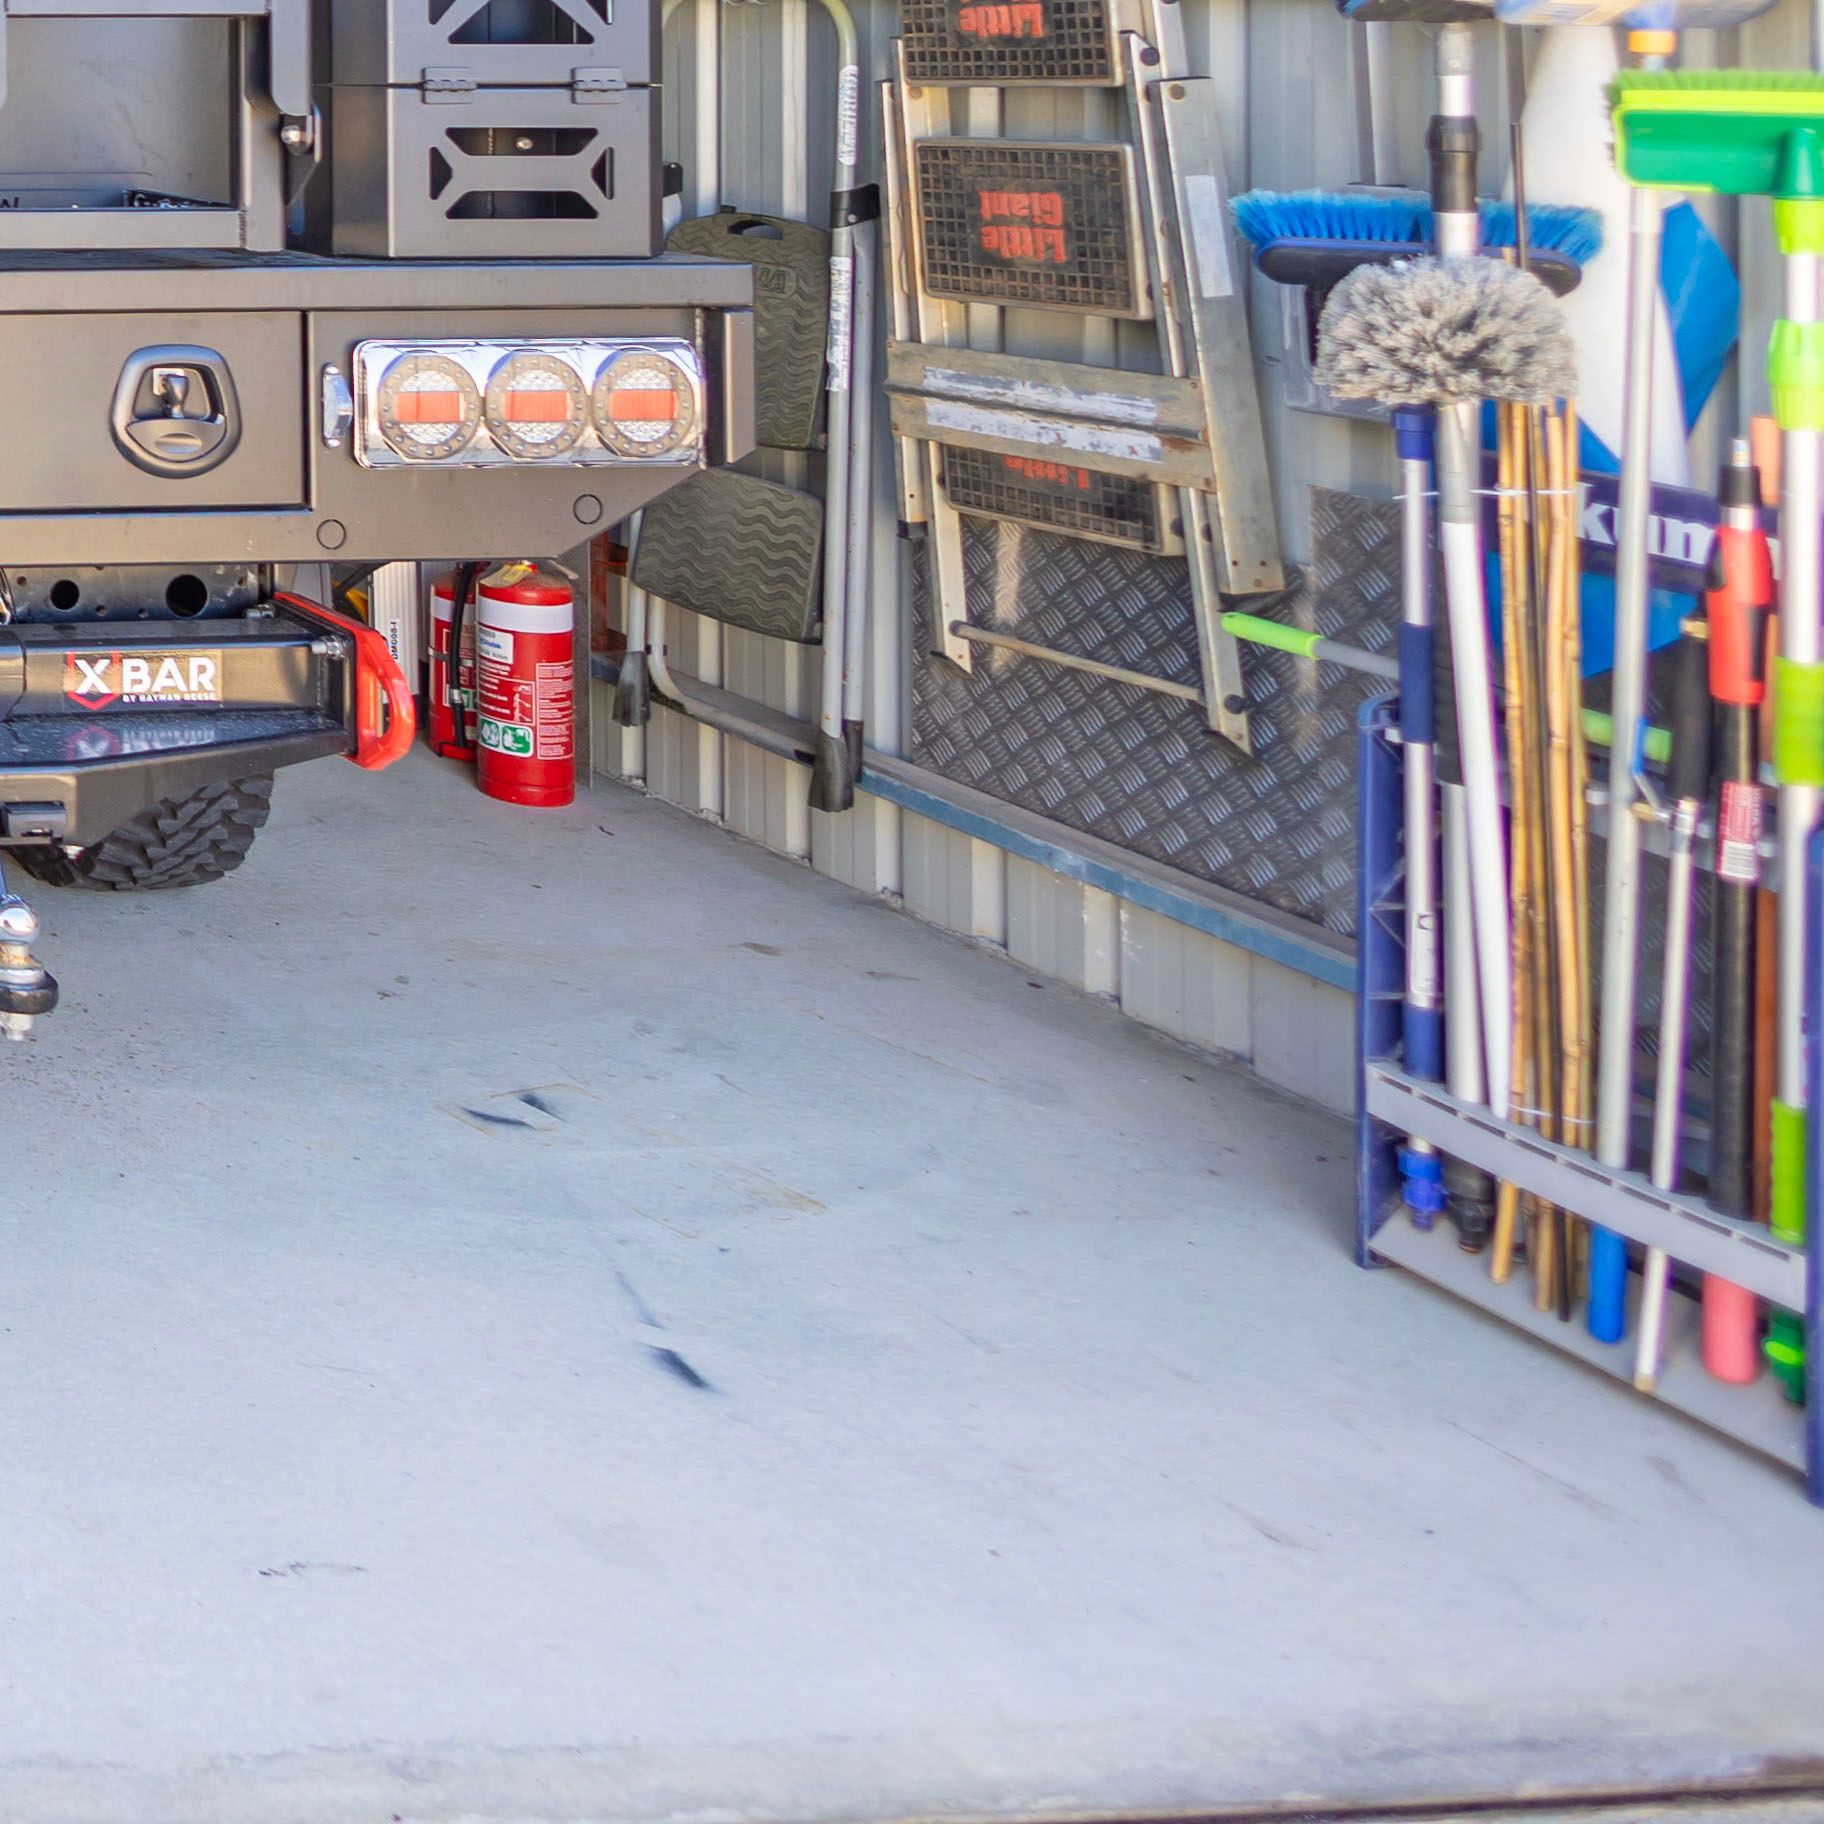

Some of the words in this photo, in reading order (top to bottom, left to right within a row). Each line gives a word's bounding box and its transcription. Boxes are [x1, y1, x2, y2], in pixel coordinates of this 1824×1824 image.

[959, 3, 1045, 40] Little
[978, 189, 1064, 227] Giant
[980, 224, 1068, 264] Little
[74, 658, 113, 695] X
[122, 656, 217, 694] BAR
